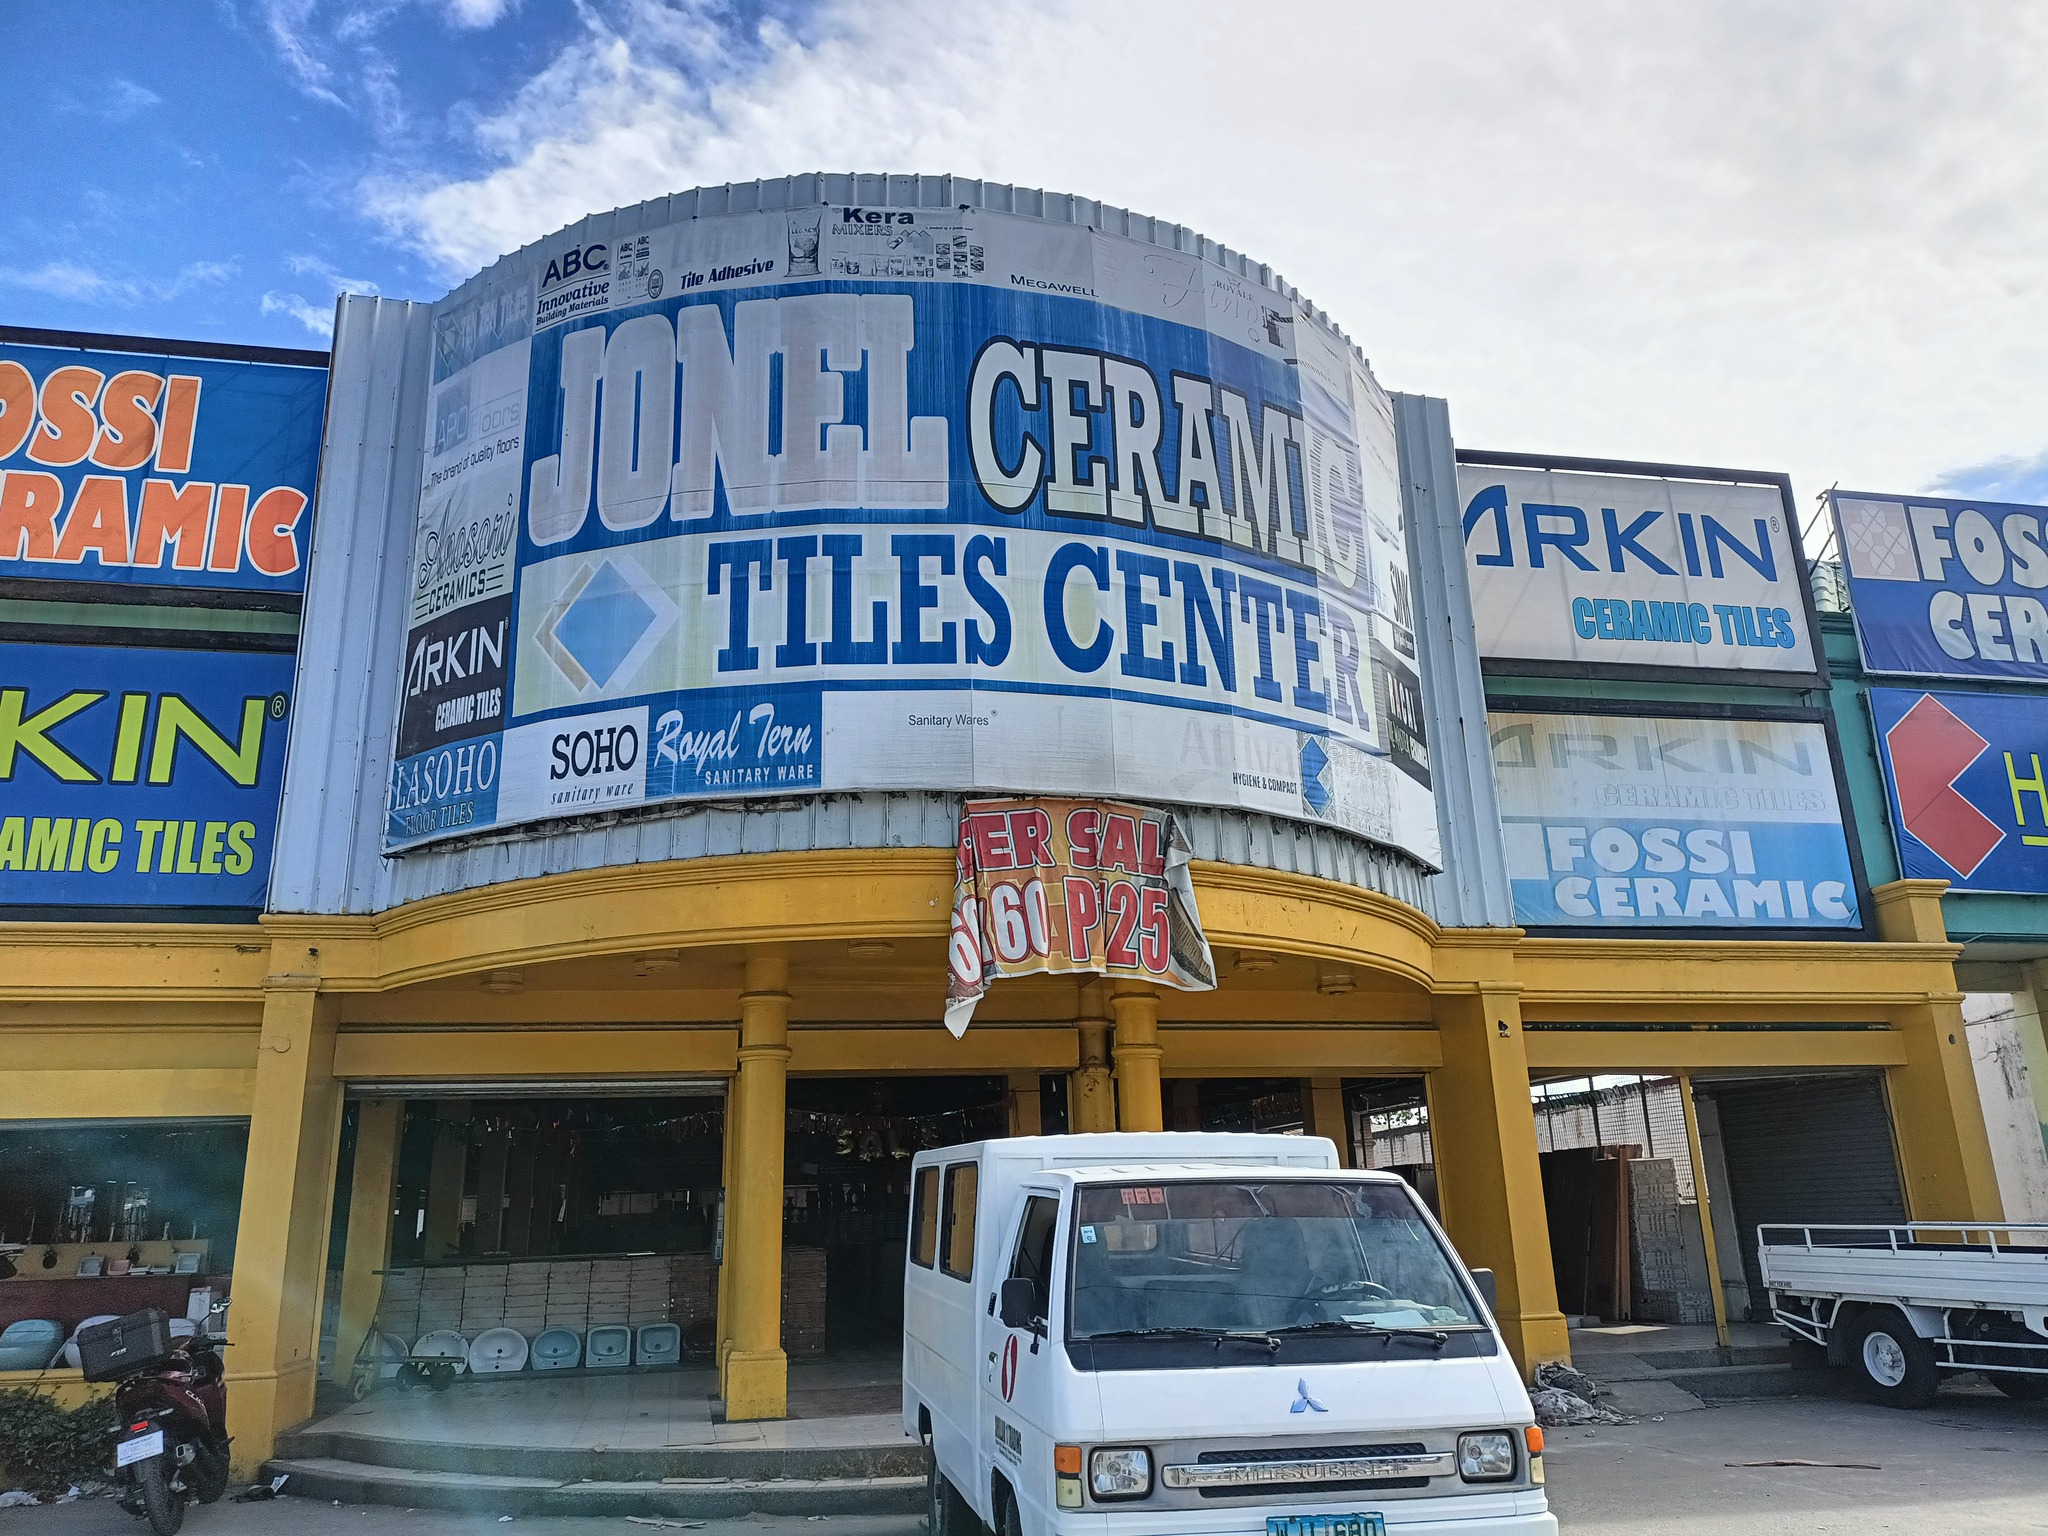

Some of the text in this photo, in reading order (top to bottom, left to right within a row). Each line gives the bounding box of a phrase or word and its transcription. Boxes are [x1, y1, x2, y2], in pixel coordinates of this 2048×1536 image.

[832, 224, 893, 237] MIXERS
[843, 207, 914, 225] Kera
[620, 243, 633, 253] ABC
[637, 236, 649, 246] ABC
[542, 244, 607, 288] ABC
[680, 258, 774, 290] Tile Adhesive
[536, 296, 608, 326] Building Materials
[537, 281, 609, 315] Innovative
[443, 458, 462, 481] brand
[470, 445, 495, 468] quality
[497, 436, 519, 455] floors
[528, 293, 1364, 589] JONEL CERAMIC
[1463, 484, 1778, 582] ARKIN
[1909, 505, 2048, 589] FOS
[428, 568, 486, 615] CERAMICS
[708, 533, 1370, 732] TILES CENTER
[1572, 596, 1796, 649] CERAMIC TILES
[401, 620, 504, 740] ARKIN
[435, 687, 501, 732] CERAMIC TILES
[908, 714, 989, 728] Sanitary Wares
[0, 686, 268, 789] KIN
[550, 724, 638, 780] SOHO
[654, 703, 813, 776] Royal Tern
[1491, 723, 1812, 776] ARKIN
[551, 782, 634, 805] sanitary ware
[705, 764, 813, 785] SANITARY WARE
[1233, 772, 1261, 789] HYGIENE
[1267, 778, 1298, 795] COMPACT
[405, 800, 474, 837] FLOOR TILES
[1595, 783, 1826, 812] CERAMIC TILES
[135, 819, 257, 876] TILES
[955, 807, 1056, 885] PER
[1546, 826, 1757, 875] FOSSI
[1555, 876, 1850, 920] CERAMIC
[1230, 1459, 1406, 1482] MITSUBISHI
